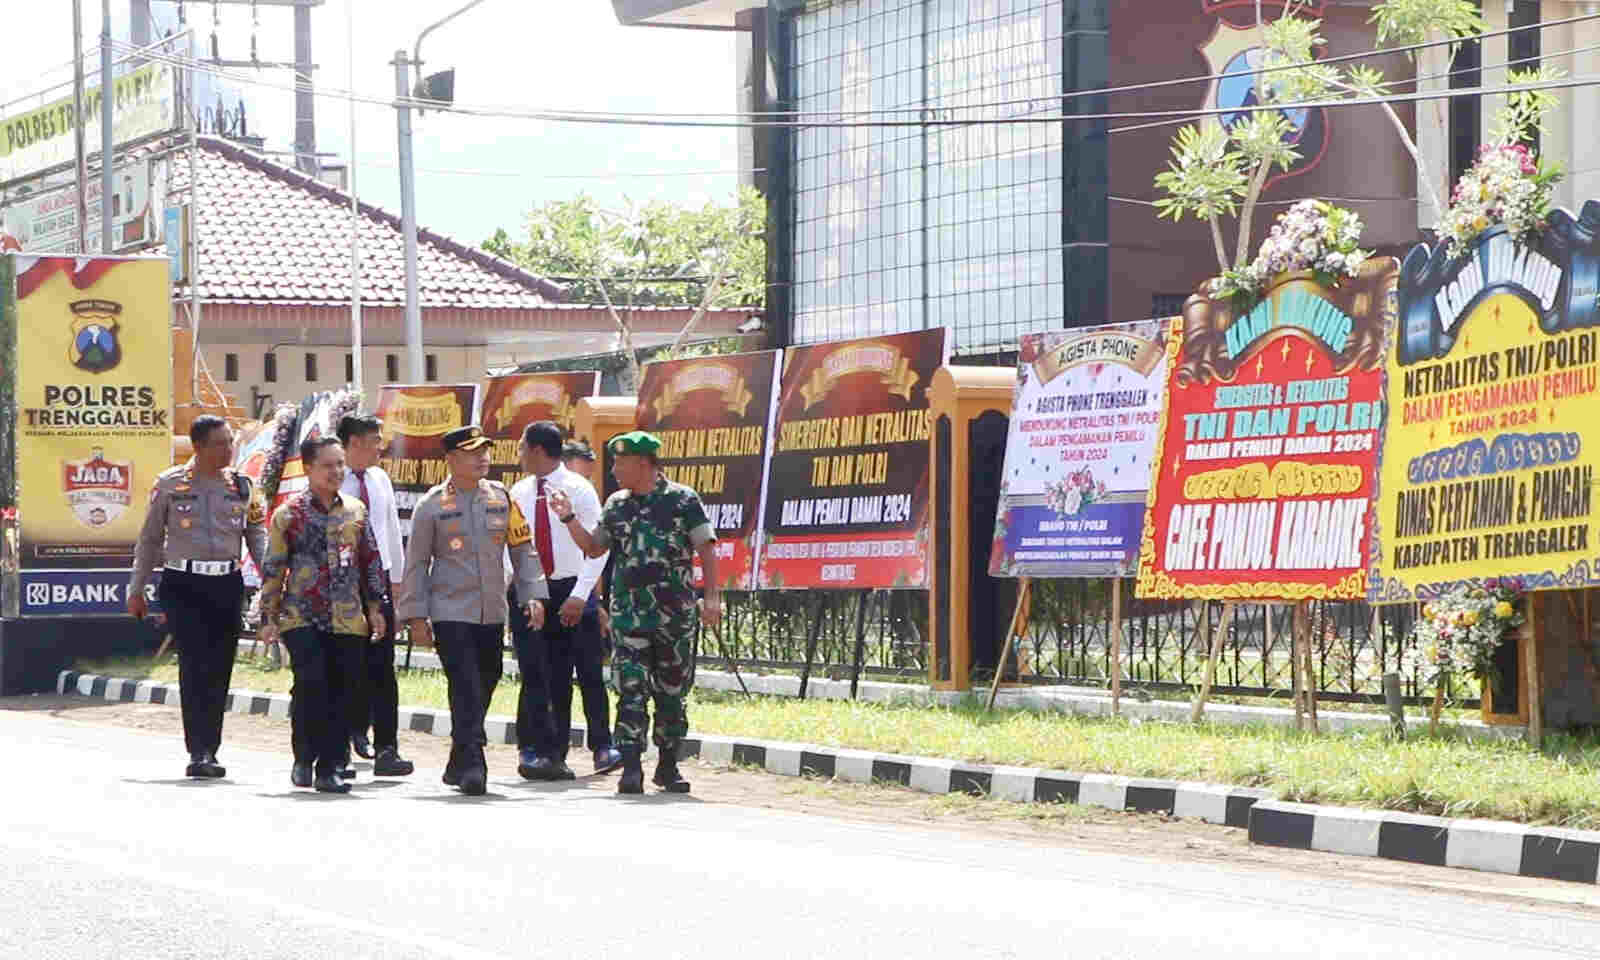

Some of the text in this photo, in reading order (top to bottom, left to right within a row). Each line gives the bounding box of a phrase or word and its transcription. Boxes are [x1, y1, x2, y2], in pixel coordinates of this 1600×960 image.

[7, 109, 56, 153] POLRES
[1058, 338, 1138, 365] AGISTA PHONE
[1403, 332, 1597, 399] NETRALITAS TNI/POLRI
[45, 385, 154, 407] POLRES
[1402, 366, 1597, 426] DALAM PENGAMANAN PEMILU
[25, 409, 168, 427] TRENGGALEK
[779, 409, 931, 451] SINERGITAS DAN NETRALITAS
[1184, 401, 1383, 441] TNI DAN POLRI
[1449, 407, 1538, 437] TAHUN 2024
[708, 425, 763, 456] NETRALITAS
[1186, 432, 1373, 461] DALAM PEMILU DAMAI 2024
[71, 466, 122, 483] JAGA
[812, 451, 889, 487] TNI DAN POLRI
[719, 503, 744, 529] 2024
[781, 493, 912, 526] DALAM PEMILU DAMAI 2024
[1396, 465, 1592, 538] DINAS PERTANIAN & PANGAN
[1166, 498, 1368, 571] CAFE PANJOL KARAOKE
[1394, 524, 1589, 570] KABUPATEN TRENGGALEK
[52, 584, 119, 602] BANK
